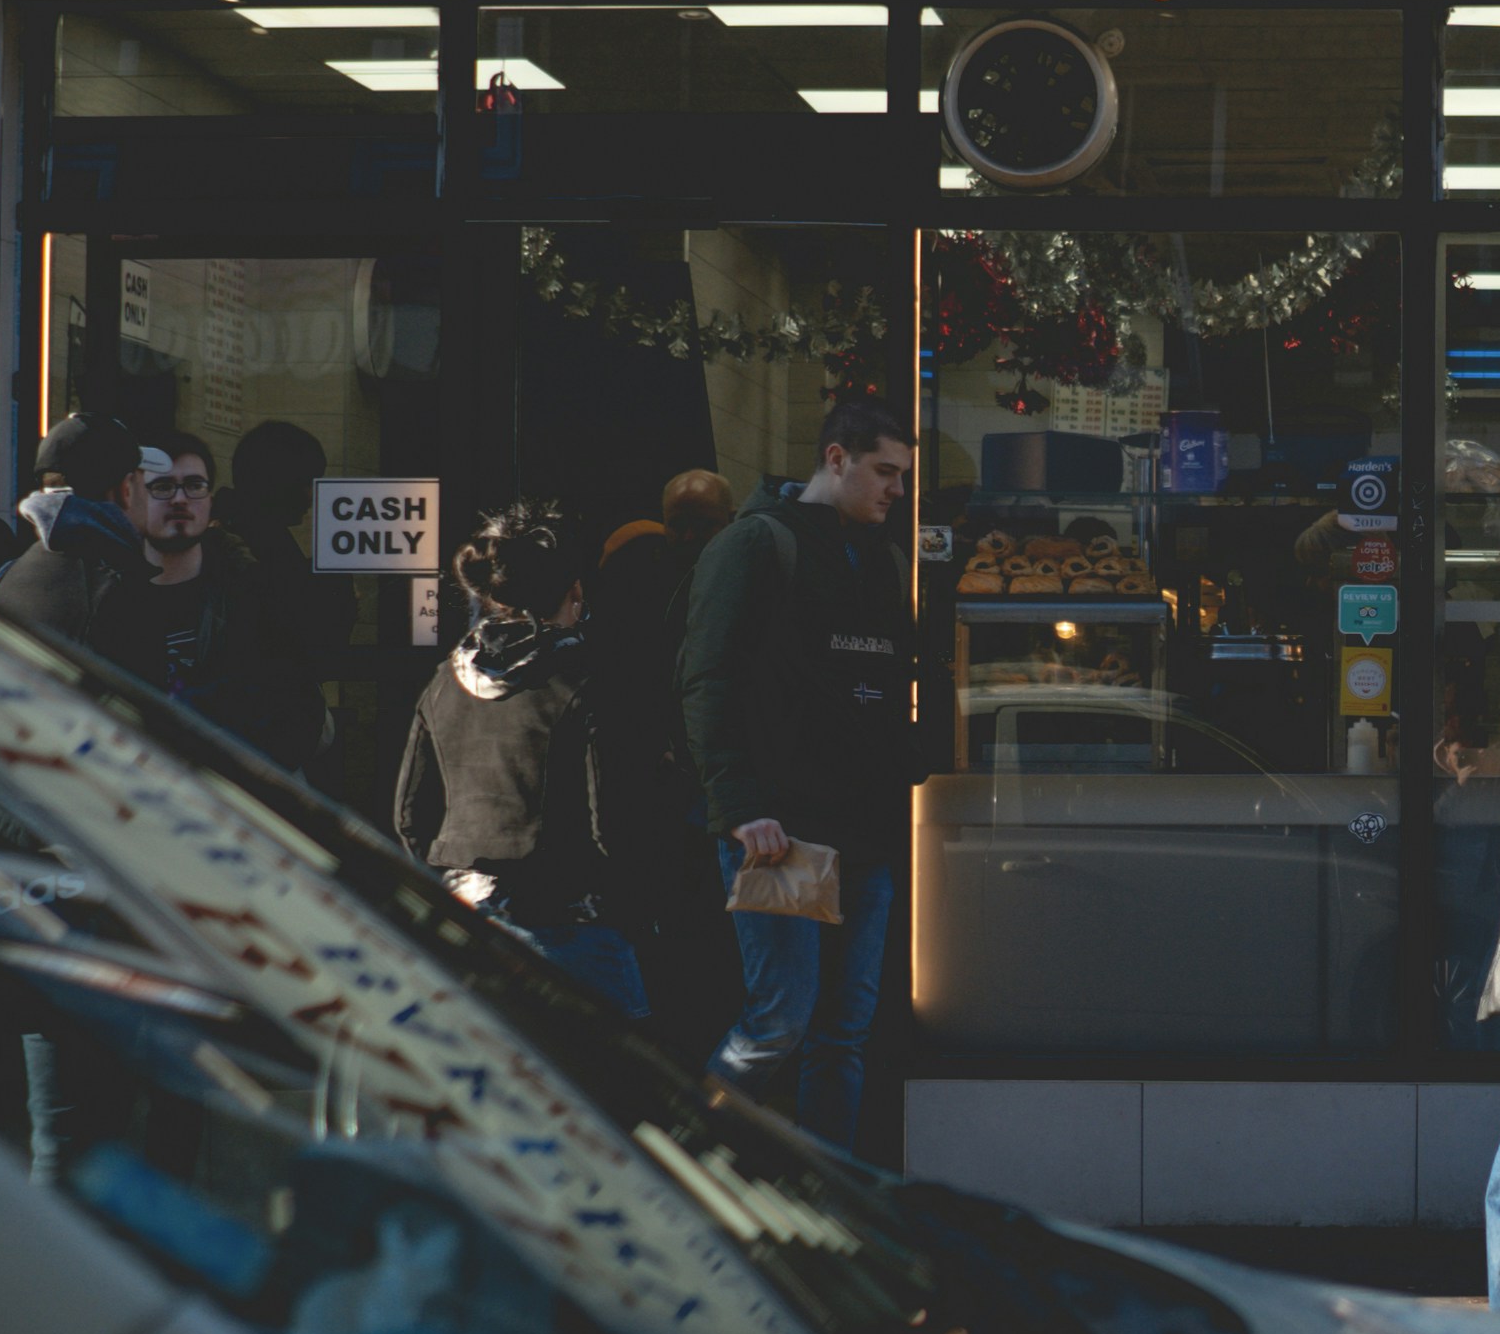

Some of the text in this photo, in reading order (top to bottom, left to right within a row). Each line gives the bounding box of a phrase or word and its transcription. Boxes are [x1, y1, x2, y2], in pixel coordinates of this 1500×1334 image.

[125, 272, 147, 299] CASH
[124, 302, 147, 327] ONLY
[1348, 460, 1393, 473] Harden's
[332, 497, 427, 521] CASH
[332, 531, 425, 555] ONLY
[1342, 592, 1393, 602] REVIEW US
